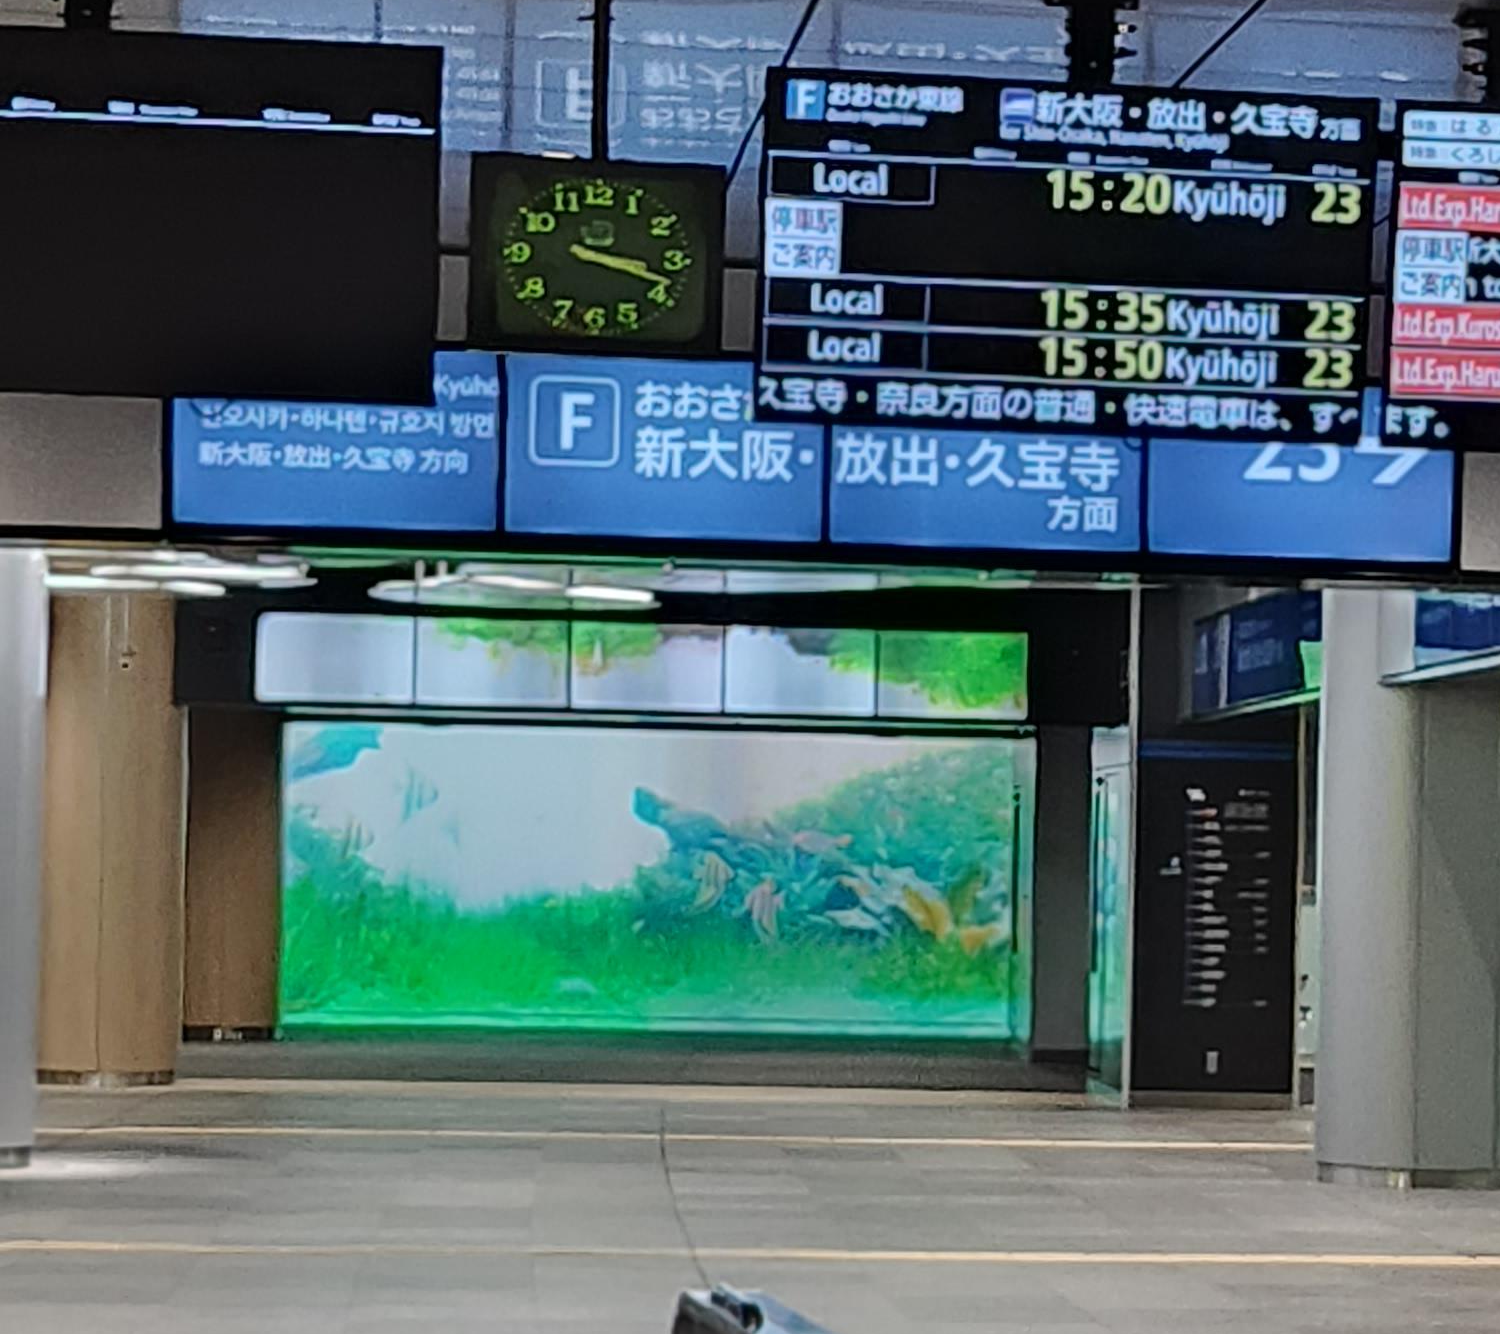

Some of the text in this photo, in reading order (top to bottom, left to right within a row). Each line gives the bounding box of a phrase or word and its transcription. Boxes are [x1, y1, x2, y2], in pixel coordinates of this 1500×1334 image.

[797, 79, 817, 117] F
[813, 162, 889, 197] Local
[1047, 169, 1171, 215] 15:20
[554, 189, 580, 212] 11
[585, 185, 614, 206] 12
[625, 195, 639, 215] 1
[1311, 181, 1362, 225] 23
[526, 211, 556, 232] 10
[650, 215, 672, 236] 2
[510, 241, 531, 263] 9
[663, 250, 685, 271] 3
[772, 242, 837, 270] ご案内
[524, 277, 545, 299] 8
[647, 284, 668, 304] 4
[1400, 271, 1461, 299] ご案内
[553, 299, 574, 327] 7
[617, 302, 639, 325] 5
[810, 283, 884, 316] Local
[1041, 289, 1166, 334] 15:35
[583, 307, 606, 330] 6
[1304, 300, 1356, 342] 23
[807, 329, 882, 363] Local
[1039, 336, 1164, 380] 15:50
[1303, 348, 1354, 389] 23
[559, 392, 595, 451] F
[1048, 497, 1118, 533] 方面
